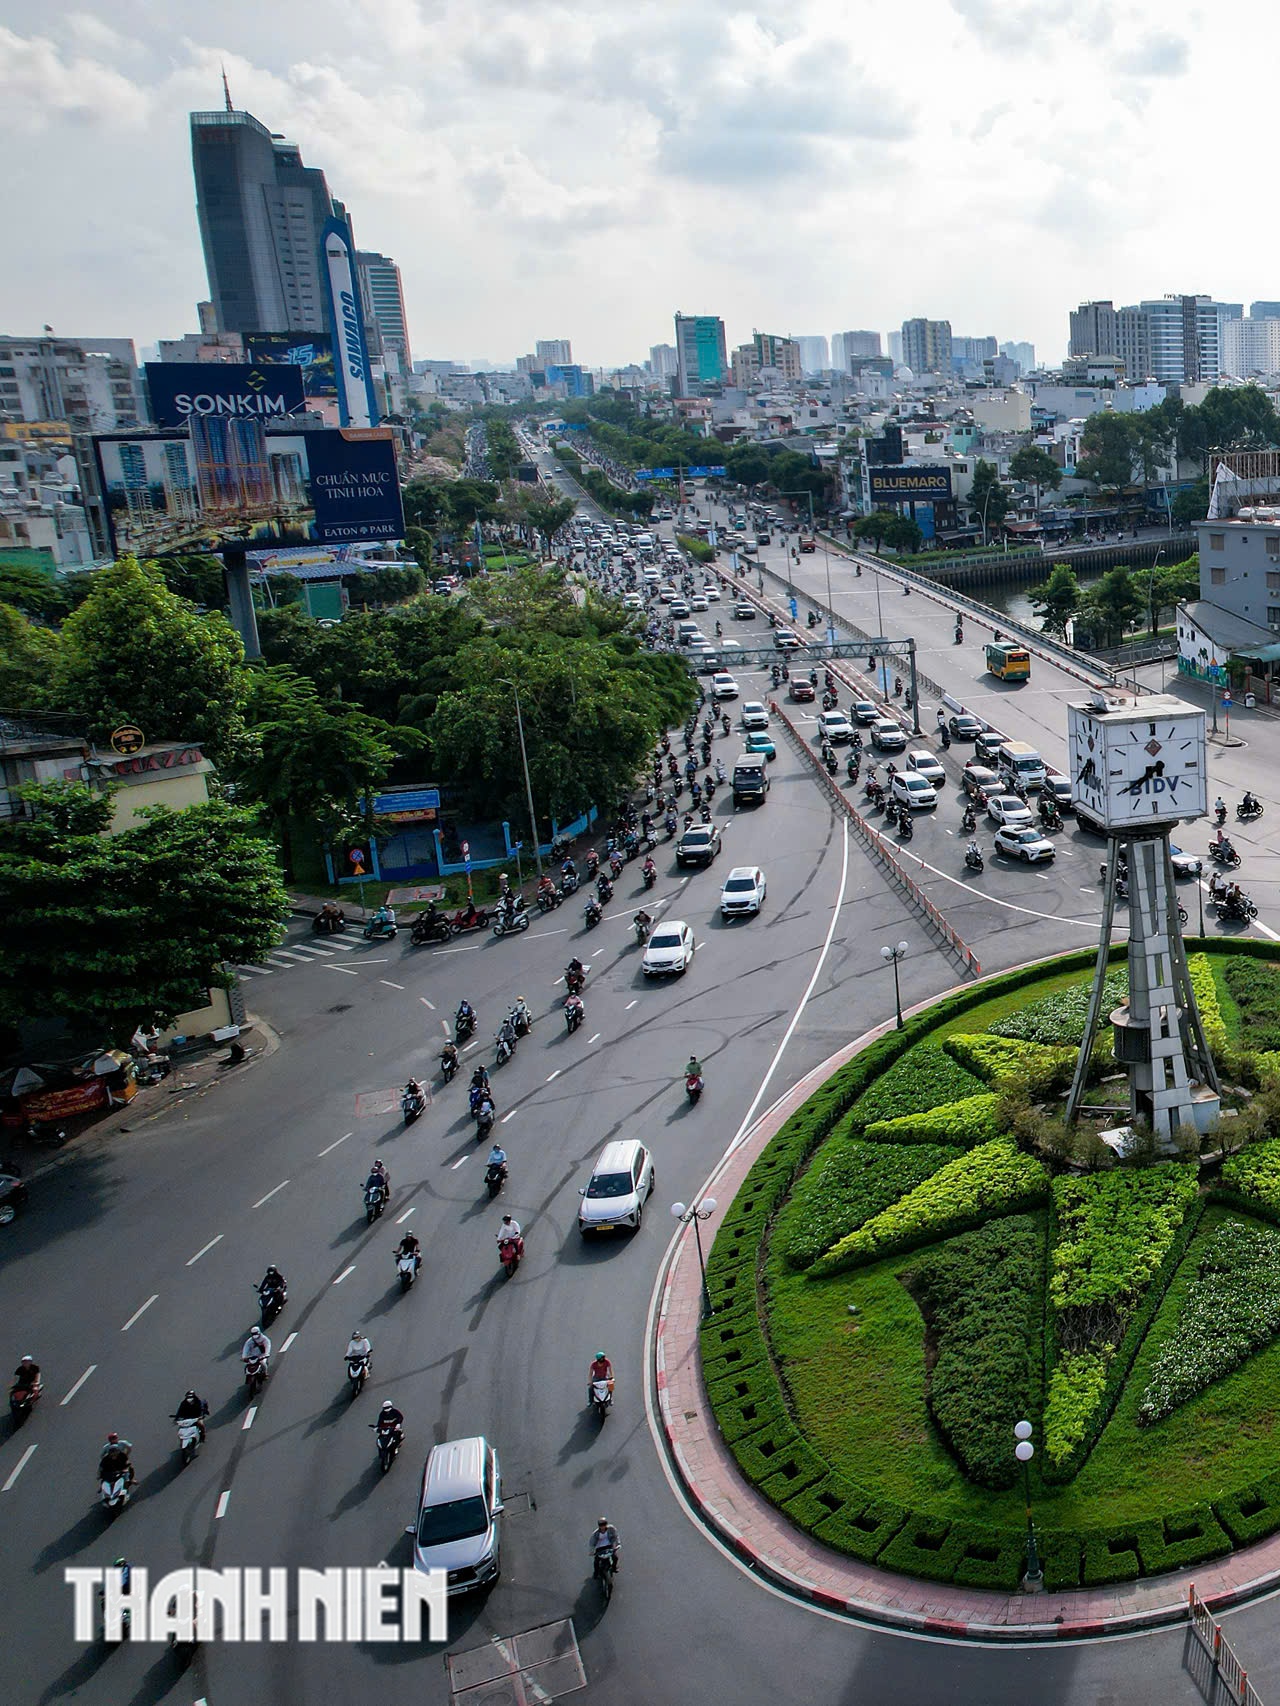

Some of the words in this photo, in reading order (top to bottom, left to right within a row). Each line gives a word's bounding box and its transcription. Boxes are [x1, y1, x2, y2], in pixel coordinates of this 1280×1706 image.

[340, 290, 364, 382] SAWACO
[175, 394, 286, 415] SONKIM
[316, 470, 359, 485] CHUẨN
[362, 472, 390, 485] MỰC
[873, 476, 947, 489] BLUEMARQ
[326, 488, 355, 499] TINH
[324, 526, 358, 537] EATON
[369, 524, 396, 534] PARK
